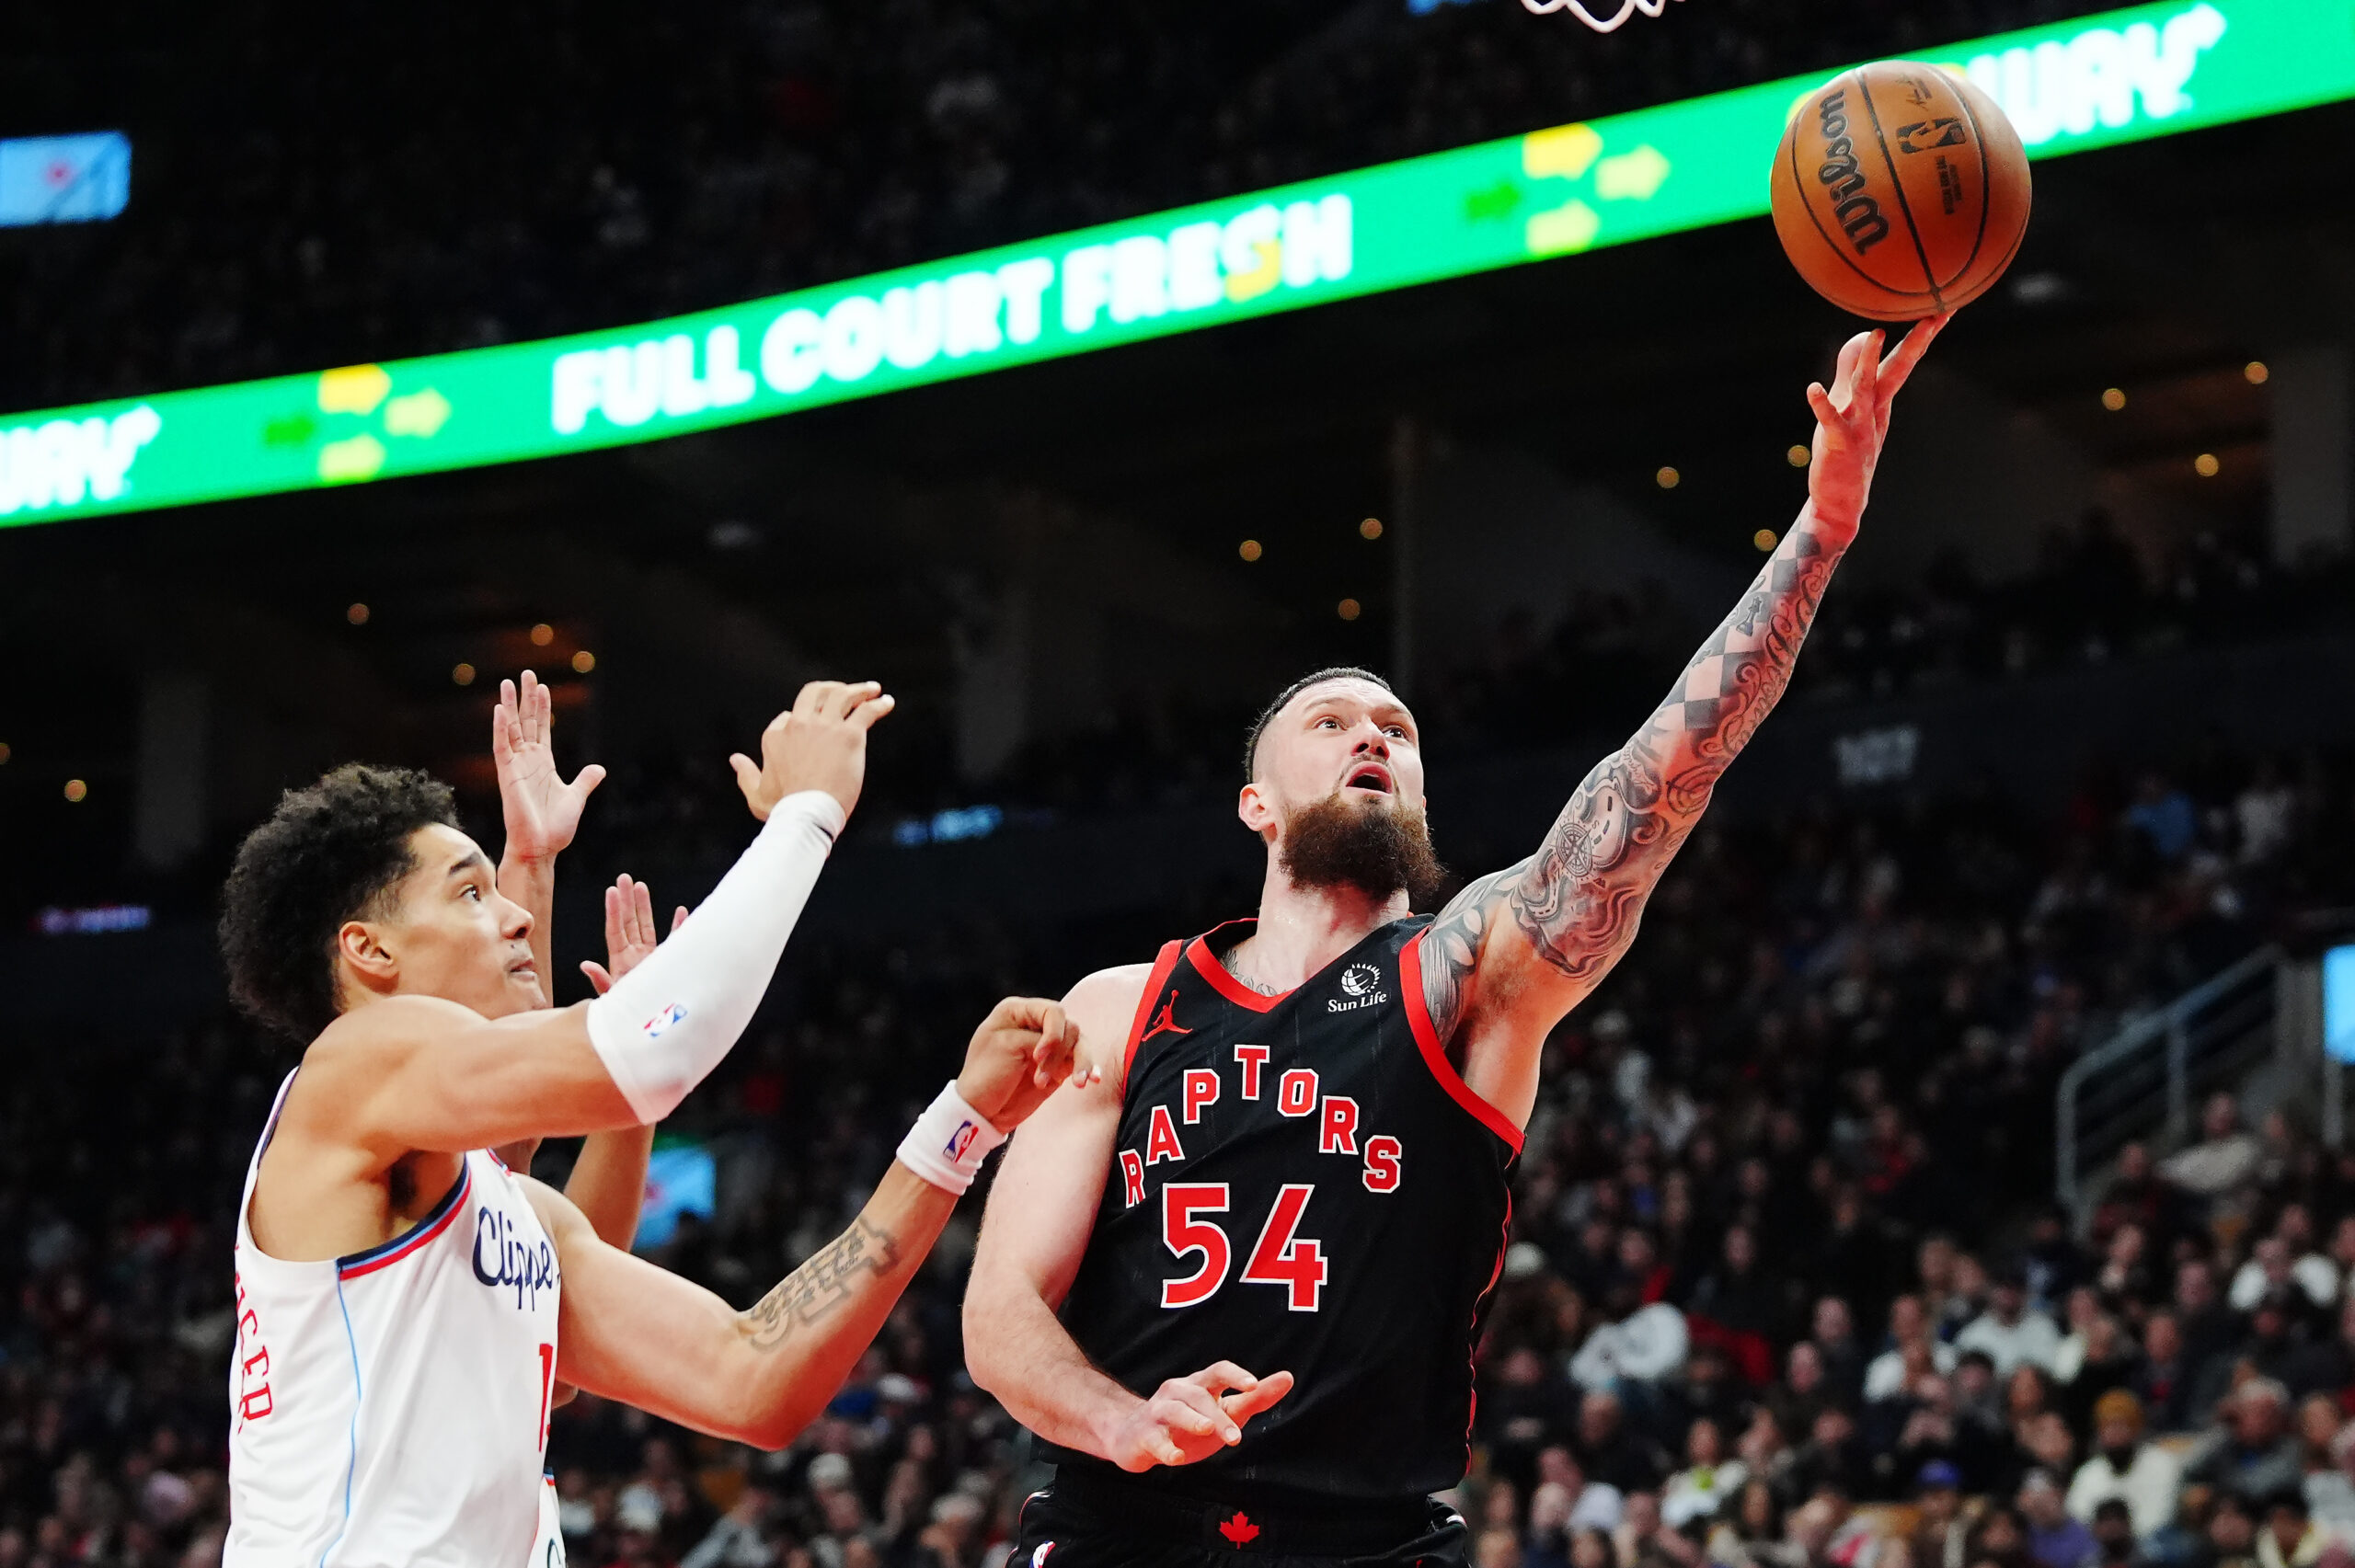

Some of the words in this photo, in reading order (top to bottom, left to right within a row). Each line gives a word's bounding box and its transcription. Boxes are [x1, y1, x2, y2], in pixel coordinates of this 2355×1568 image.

[1819, 88, 1890, 257] Wilson
[552, 324, 755, 434] FULL
[762, 257, 1054, 393] COURT
[1062, 193, 1352, 333] FRESH
[1327, 999, 1357, 1013] Sun
[1360, 990, 1387, 1008] Life
[1119, 1045, 1402, 1208] RAPTORS
[1160, 1183, 1327, 1312] 54
[538, 1343, 554, 1452] 1
